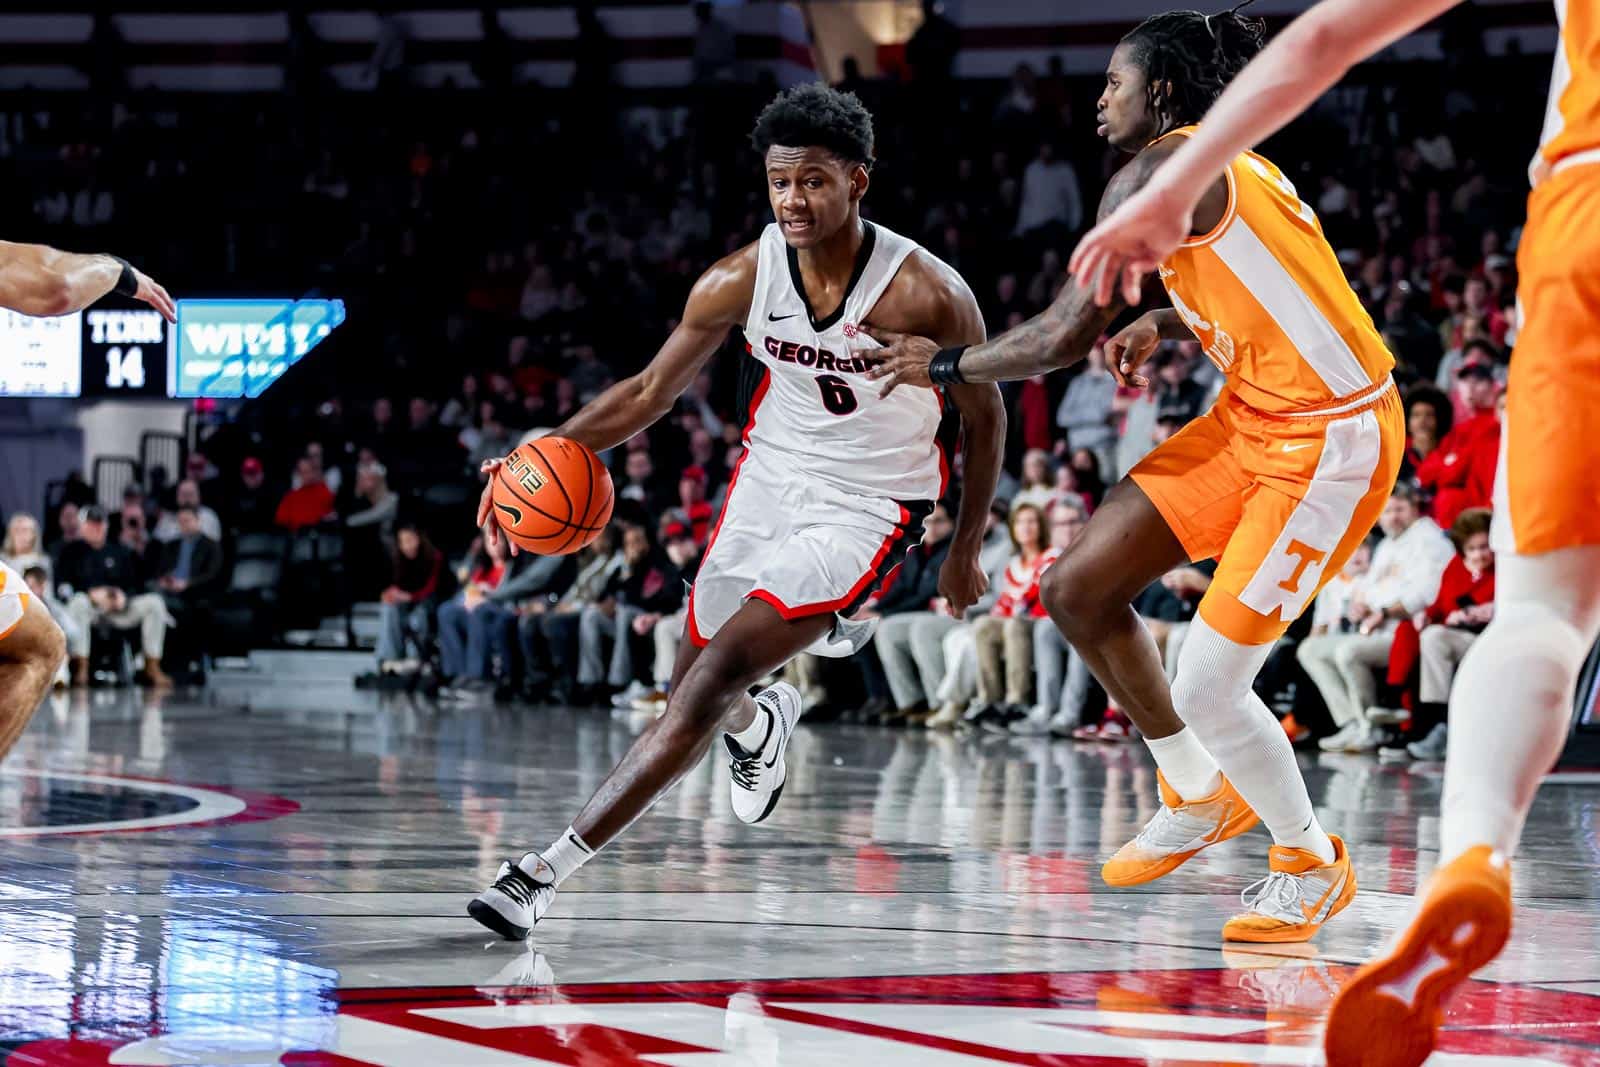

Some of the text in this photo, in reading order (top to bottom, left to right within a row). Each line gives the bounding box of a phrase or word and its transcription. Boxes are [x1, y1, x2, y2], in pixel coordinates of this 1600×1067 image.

[106, 347, 145, 388] 14
[814, 374, 859, 416] 6
[504, 451, 543, 496] ELITE
[1277, 538, 1327, 594] T
